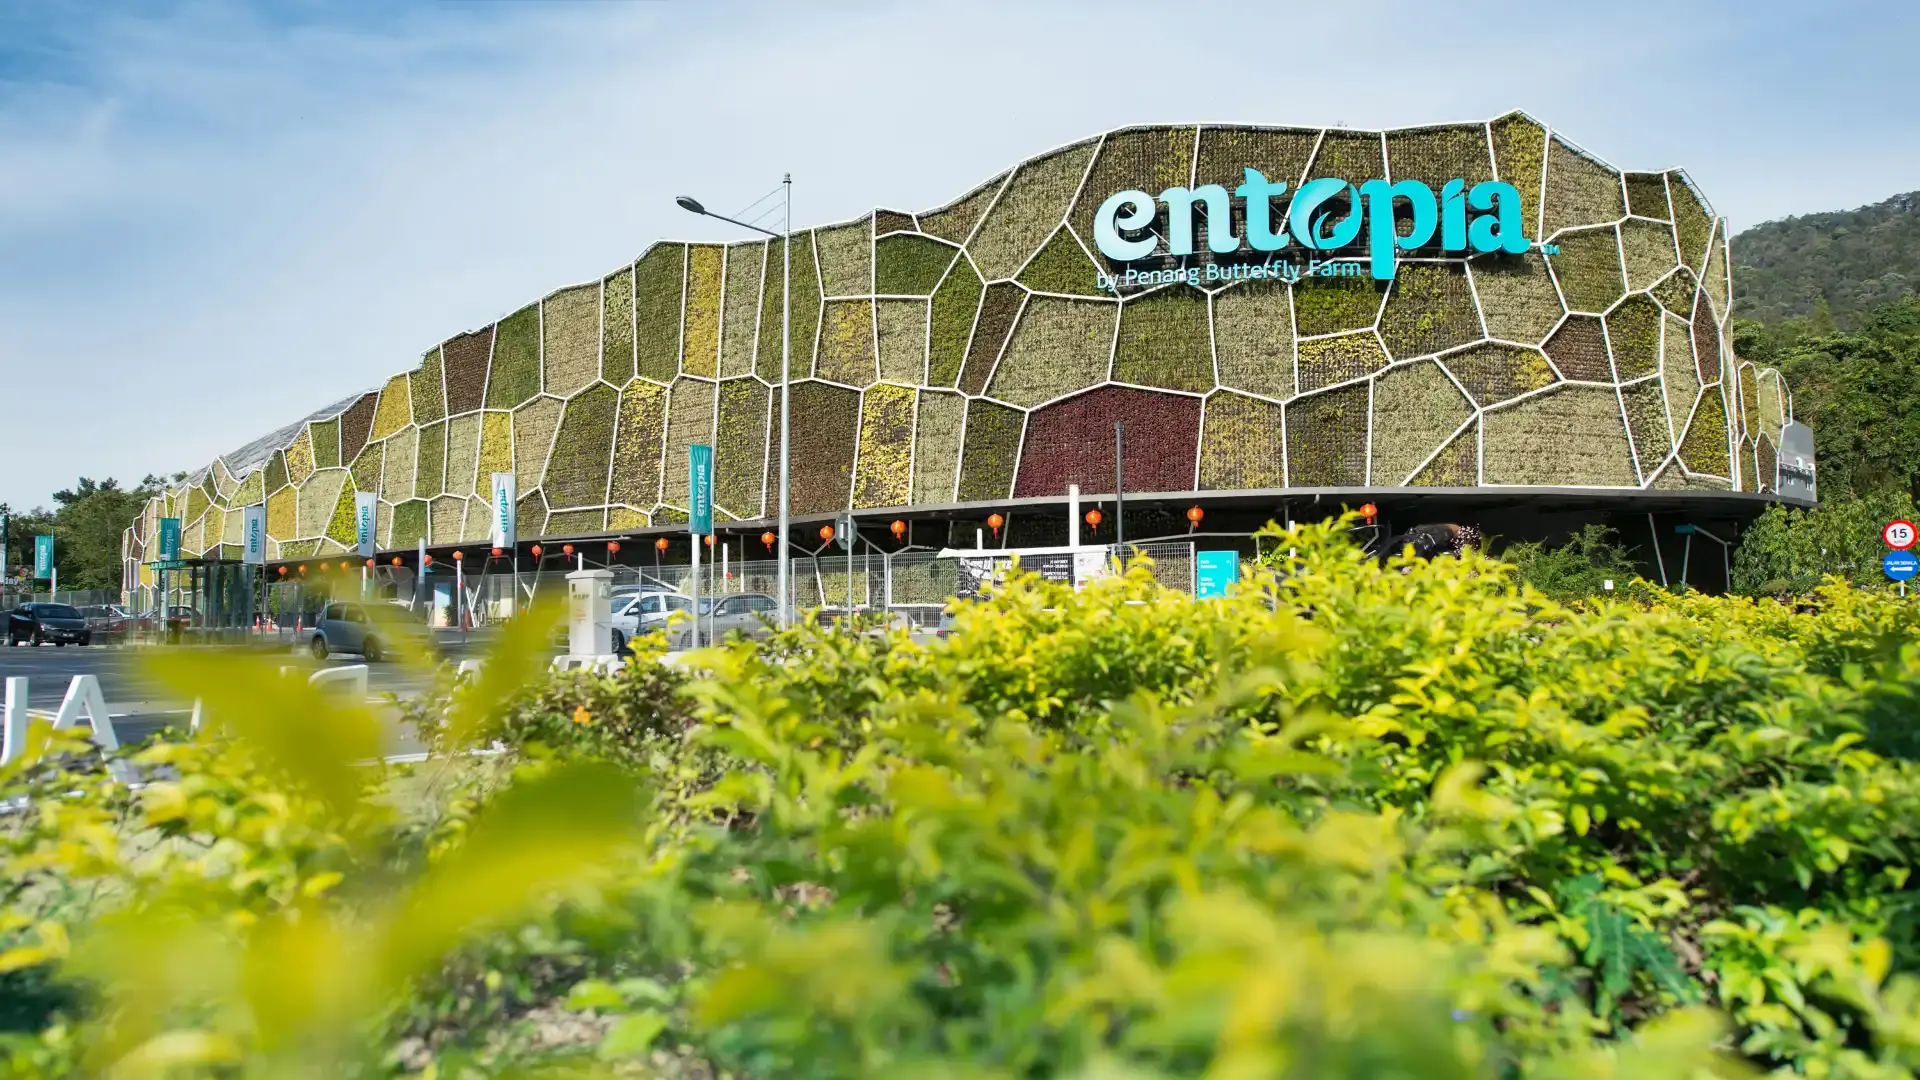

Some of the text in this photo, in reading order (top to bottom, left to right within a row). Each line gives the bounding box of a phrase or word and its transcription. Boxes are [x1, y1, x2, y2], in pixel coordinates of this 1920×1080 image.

[1093, 167, 1531, 280] entopia
[1096, 259, 1361, 292] by Penang Butterfly Farm
[500, 488, 509, 533] entopia
[697, 464, 708, 517] entopia
[250, 519, 259, 553] entopia
[360, 504, 370, 544] entopia
[1891, 528, 1907, 539] 15
